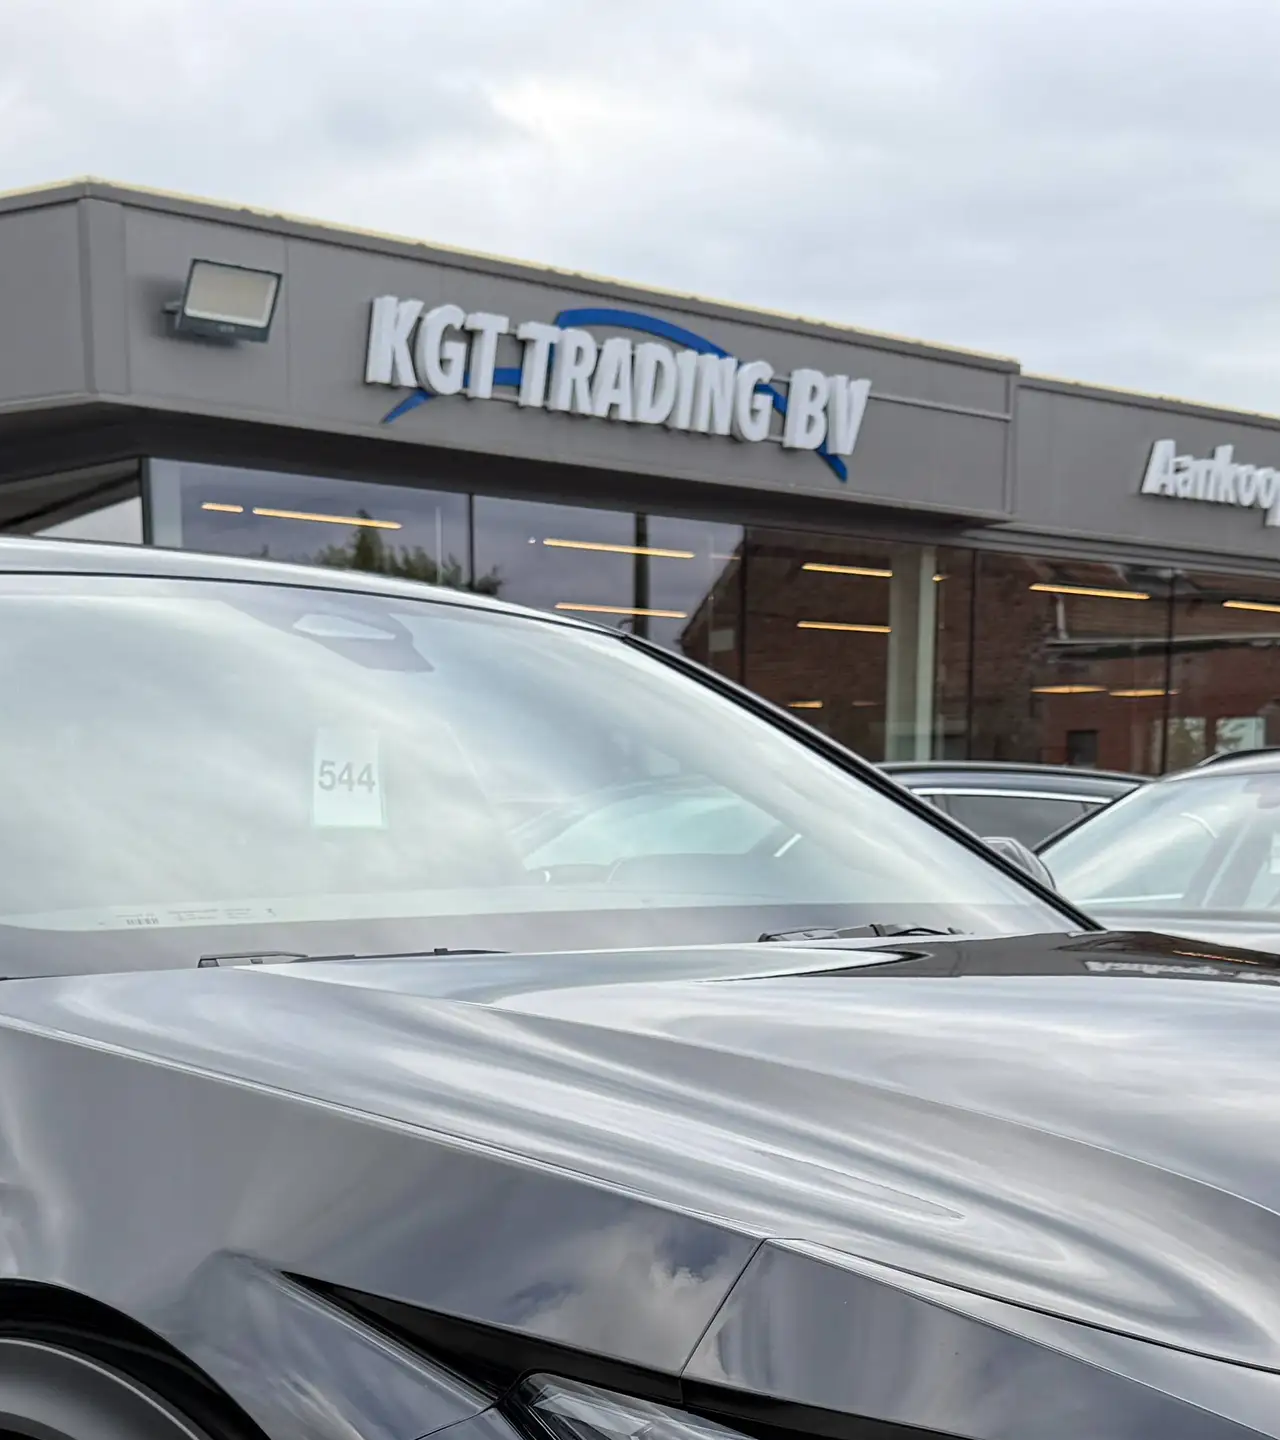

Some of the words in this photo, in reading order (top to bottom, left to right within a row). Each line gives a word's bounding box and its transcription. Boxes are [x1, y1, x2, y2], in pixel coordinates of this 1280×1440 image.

[365, 295, 509, 400] KGT
[517, 321, 774, 442] TRADING
[782, 368, 871, 455] BV
[318, 759, 376, 794] 544
